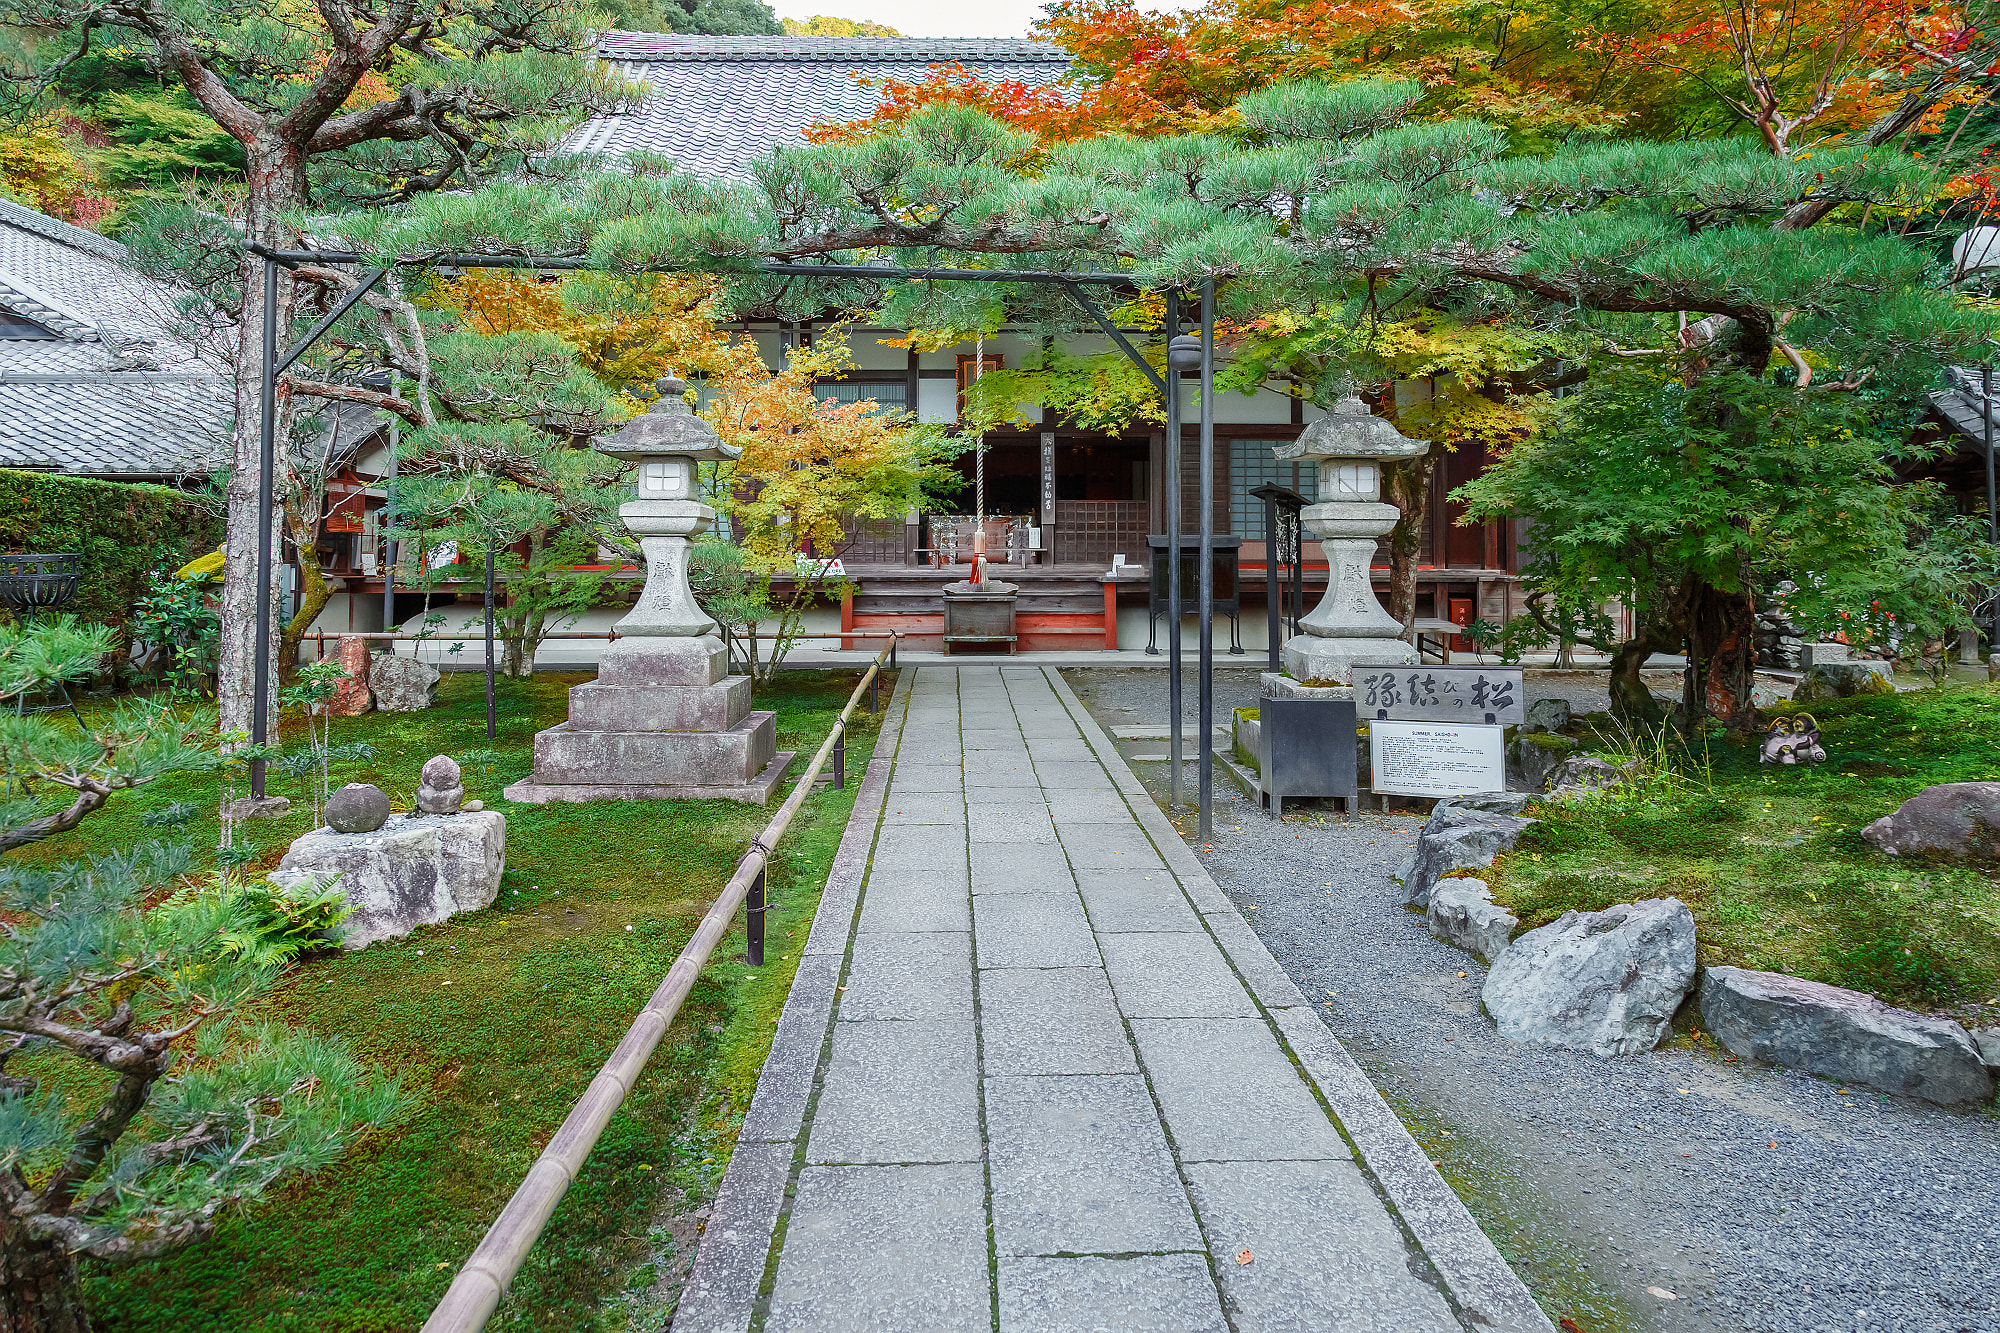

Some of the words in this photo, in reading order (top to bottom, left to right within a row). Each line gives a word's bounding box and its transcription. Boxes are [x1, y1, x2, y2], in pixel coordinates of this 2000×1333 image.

[1363, 672, 1514, 712] 縁結びの松
